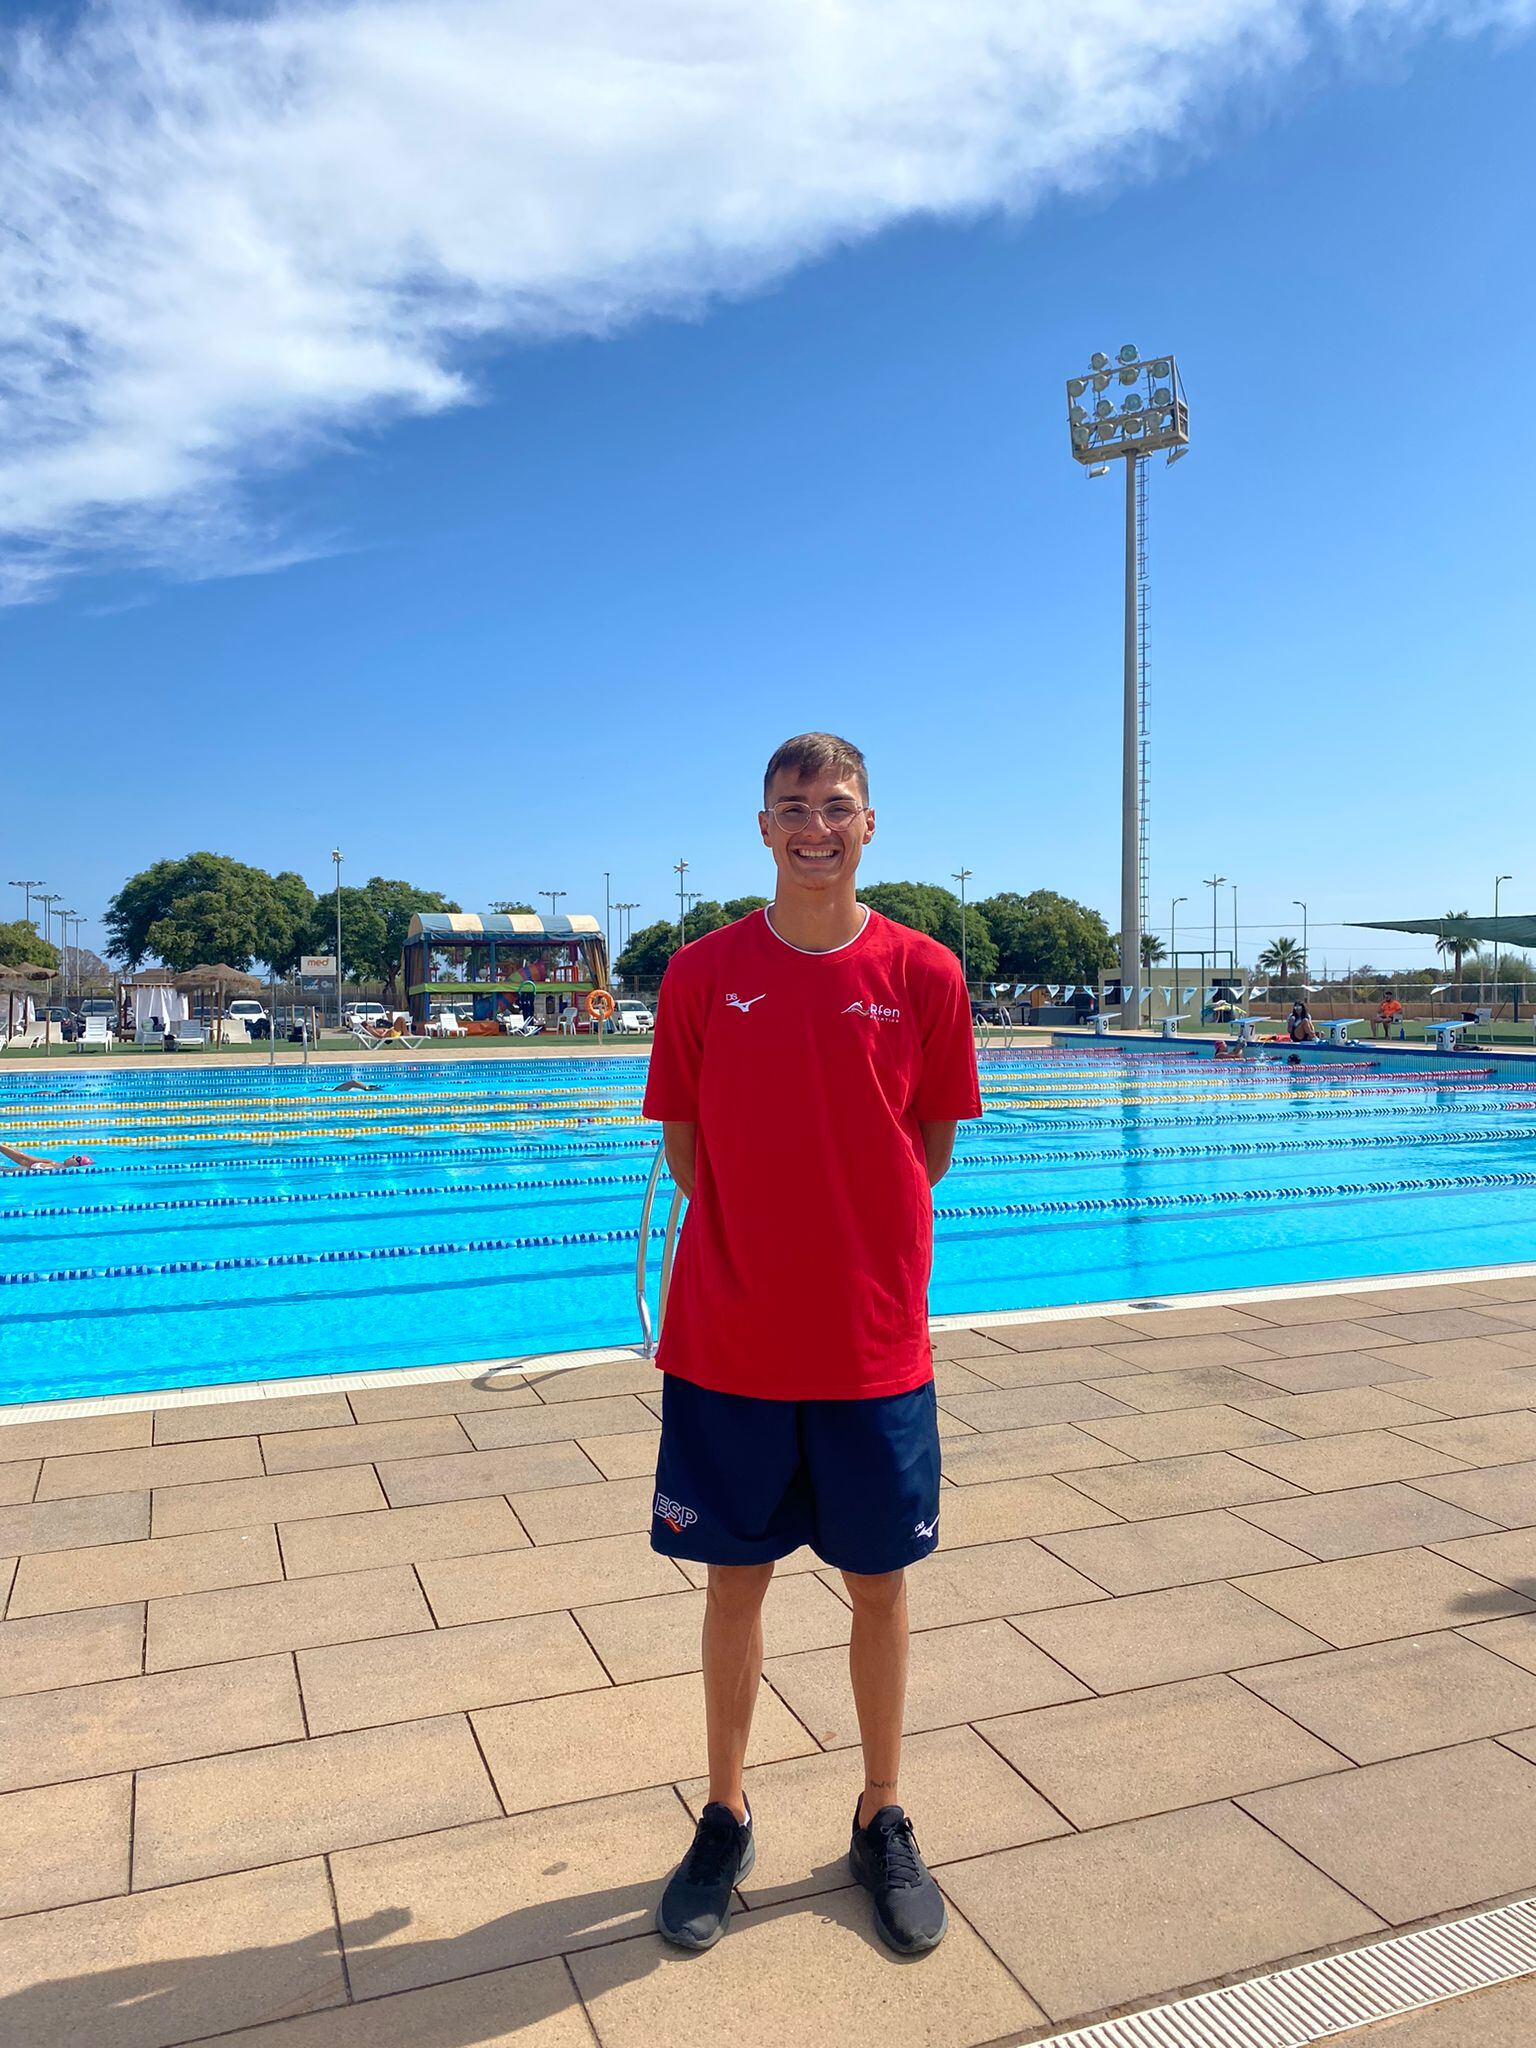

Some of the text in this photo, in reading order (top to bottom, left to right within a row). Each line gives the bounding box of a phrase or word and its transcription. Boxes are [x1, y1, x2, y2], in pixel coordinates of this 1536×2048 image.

[870, 1003, 900, 1018] Rfen
[1103, 1020, 1108, 1030] 9
[1171, 1022, 1176, 1032] 8
[1249, 1024, 1255, 1036] 7
[1341, 1027, 1346, 1039] 6
[1450, 1030, 1455, 1043] 5
[654, 1492, 698, 1528] ESP
